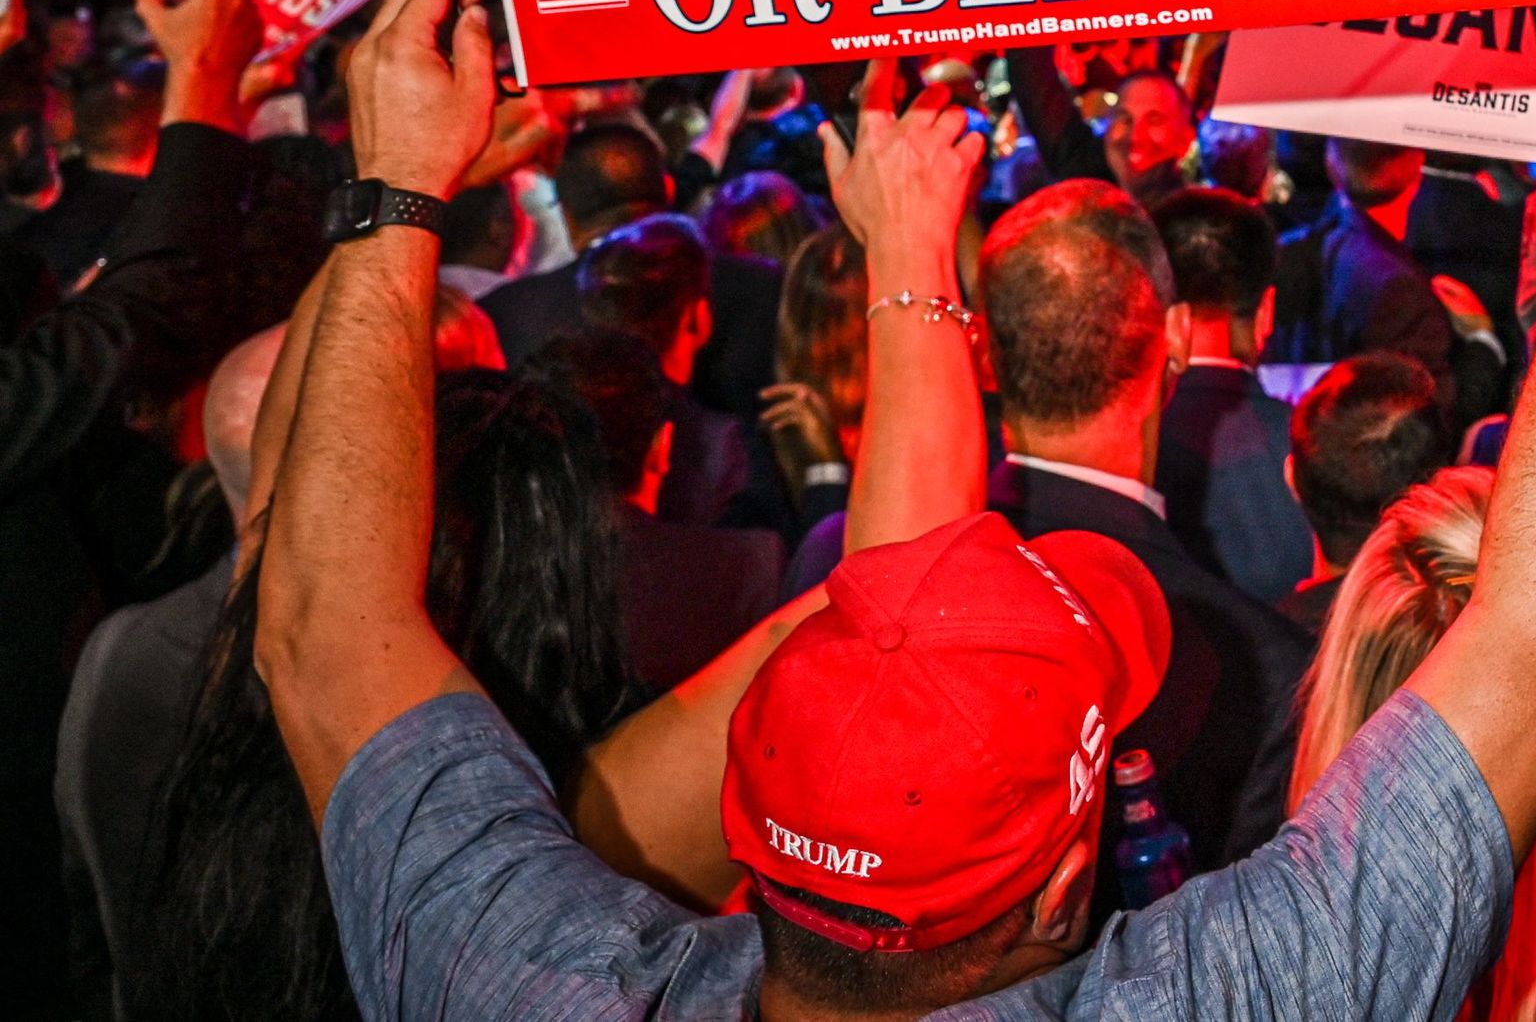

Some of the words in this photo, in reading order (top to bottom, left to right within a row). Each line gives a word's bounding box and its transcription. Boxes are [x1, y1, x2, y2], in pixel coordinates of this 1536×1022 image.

[831, 6, 1213, 51] www.TrumpHandBanners.com
[1432, 81, 1530, 114] DESANTIS
[766, 818, 882, 879] TRUMP
